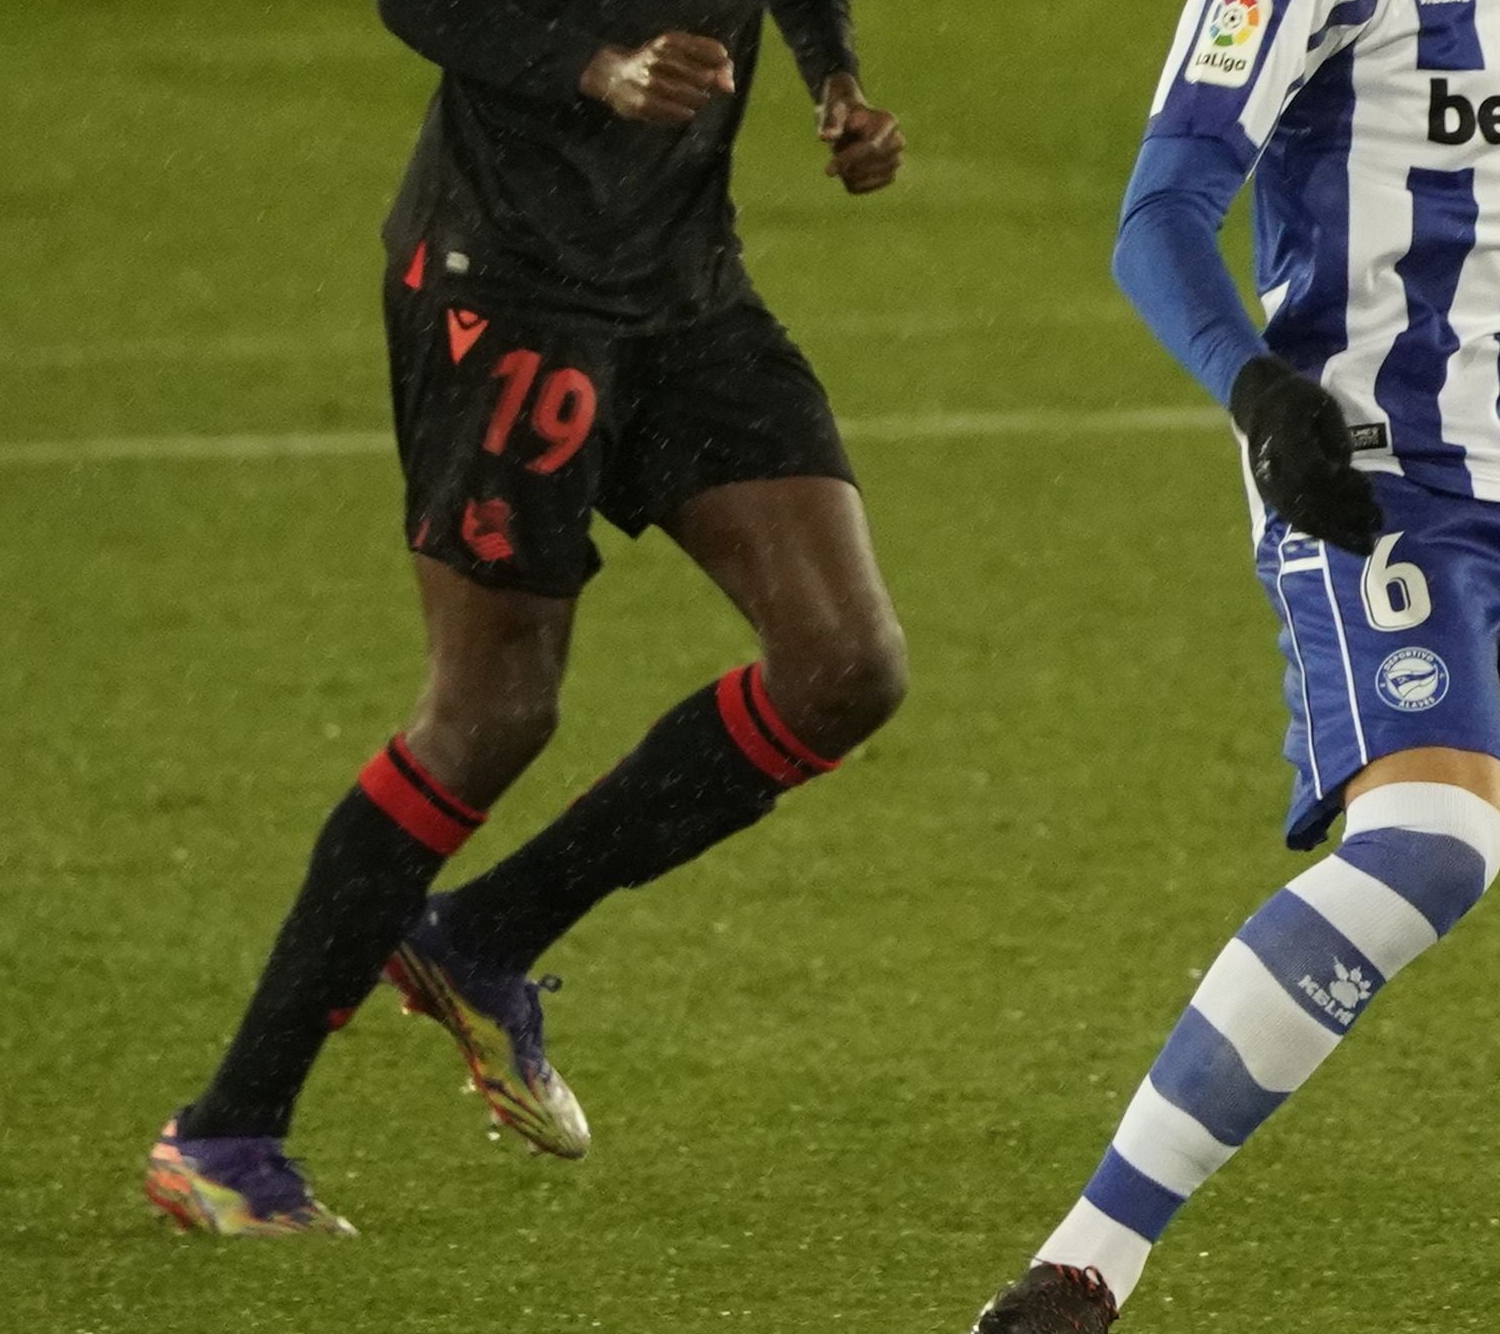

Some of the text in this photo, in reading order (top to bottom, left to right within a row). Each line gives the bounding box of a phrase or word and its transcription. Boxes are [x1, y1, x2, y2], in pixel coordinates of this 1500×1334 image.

[1195, 51, 1248, 73] LaLiga
[482, 347, 597, 475] 19
[1360, 530, 1432, 632] 6
